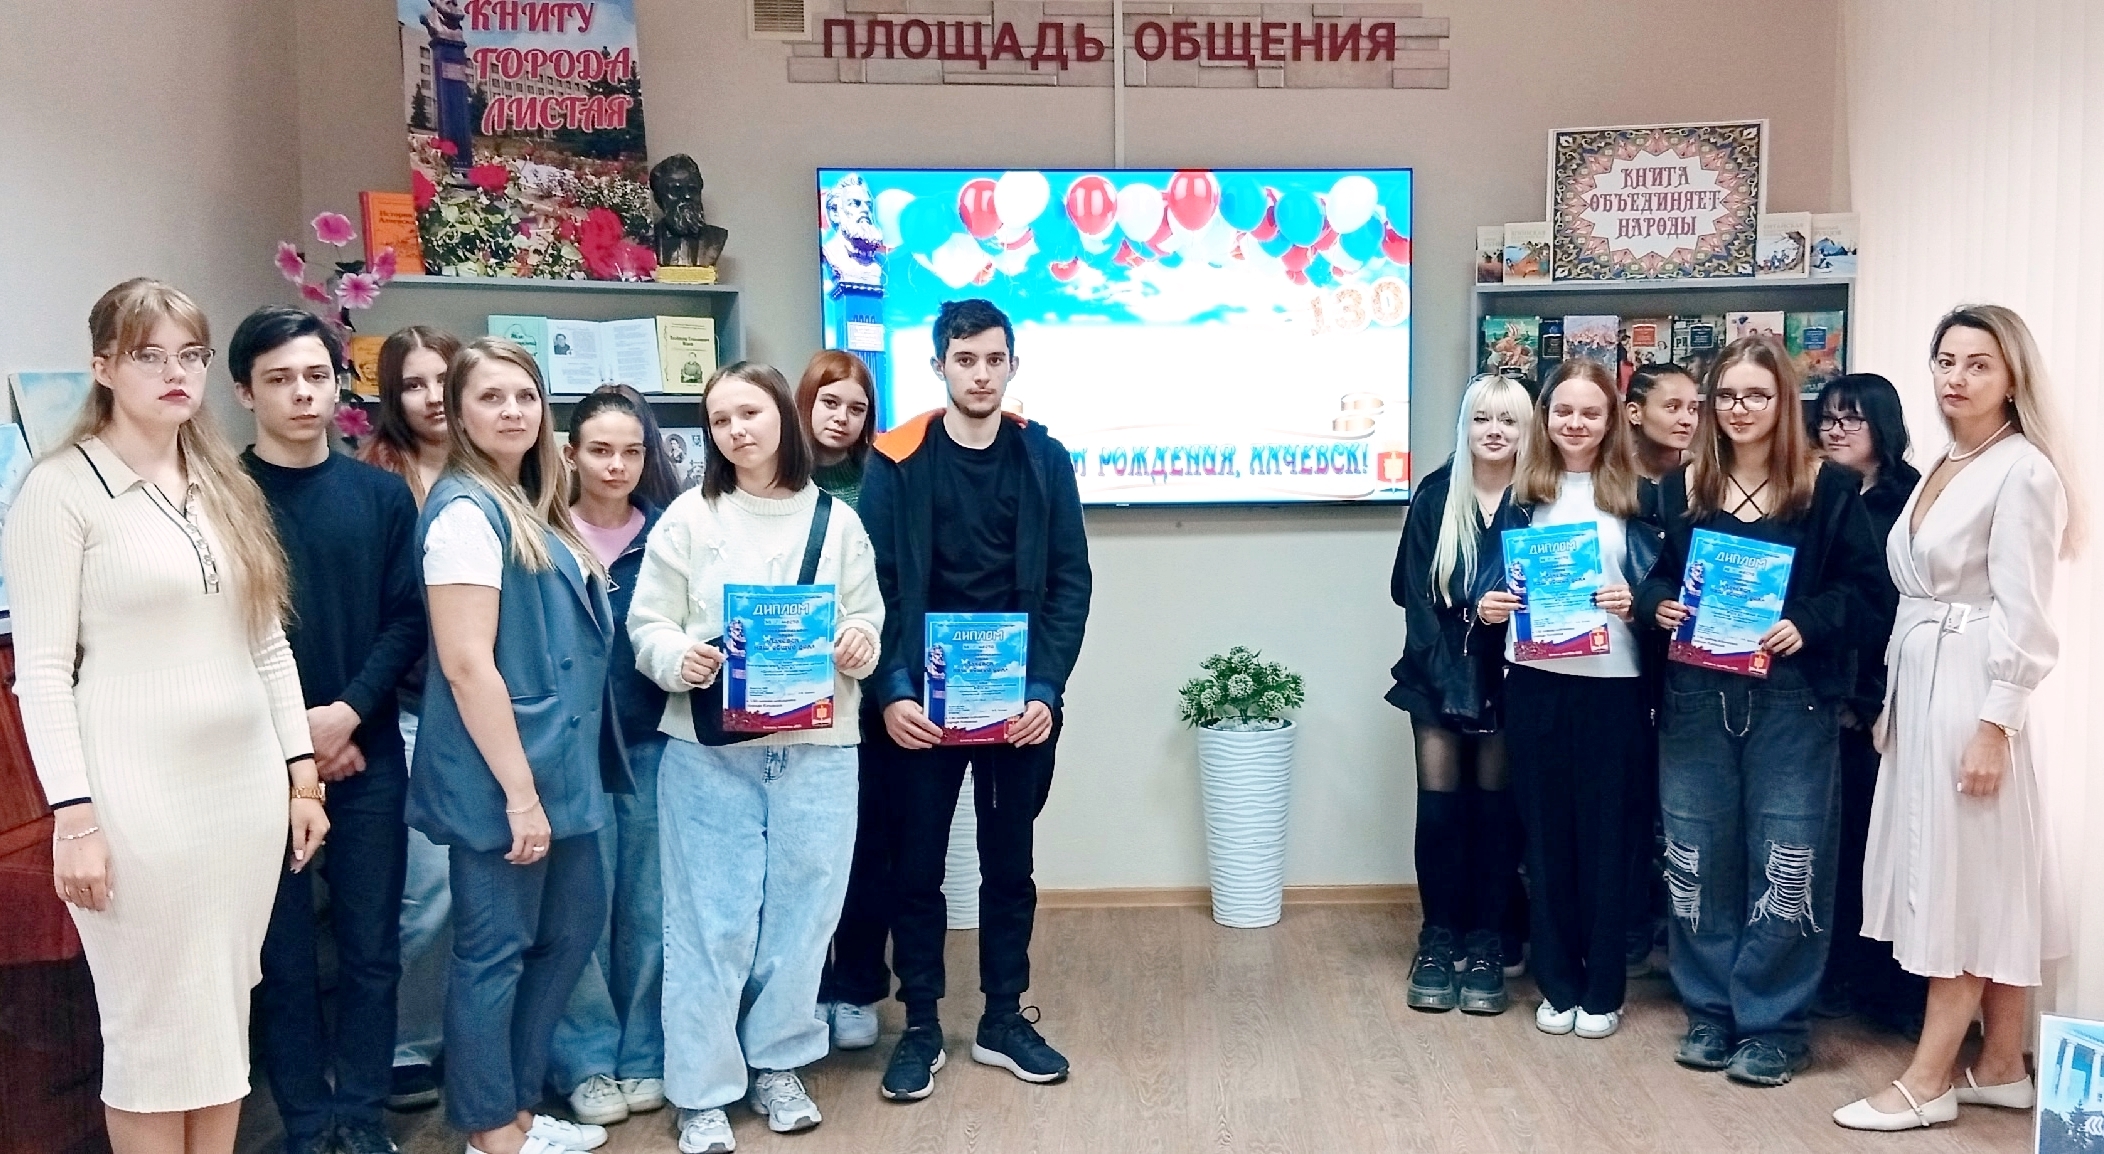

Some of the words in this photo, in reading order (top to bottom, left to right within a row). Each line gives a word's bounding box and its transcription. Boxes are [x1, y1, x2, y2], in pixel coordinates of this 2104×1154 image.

[464, 0, 595, 33] КНИГУ
[824, 19, 1105, 70] ПЛОЩАДЬ
[1134, 21, 1395, 70] ОБЩЕНИЯ
[473, 47, 631, 85] ГОРОДА
[482, 94, 633, 135] ЛИСТАЯ
[1620, 166, 1691, 189] КНИГА
[1589, 190, 1721, 214] ОБЪЕДИНЯЕТ
[1615, 216, 1697, 239] НАРОДЫ
[1310, 281, 1404, 336] 130
[1098, 443, 1241, 485] РОЖДЕНИЯ,
[1249, 442, 1370, 476] АЛЧЕВСК!
[1528, 540, 1578, 555] ДИПЛОМ
[1714, 551, 1768, 571] ДИПЛОМ
[752, 603, 811, 616] ДИПЛОМ
[952, 630, 1004, 642] ДИПЛОМ
